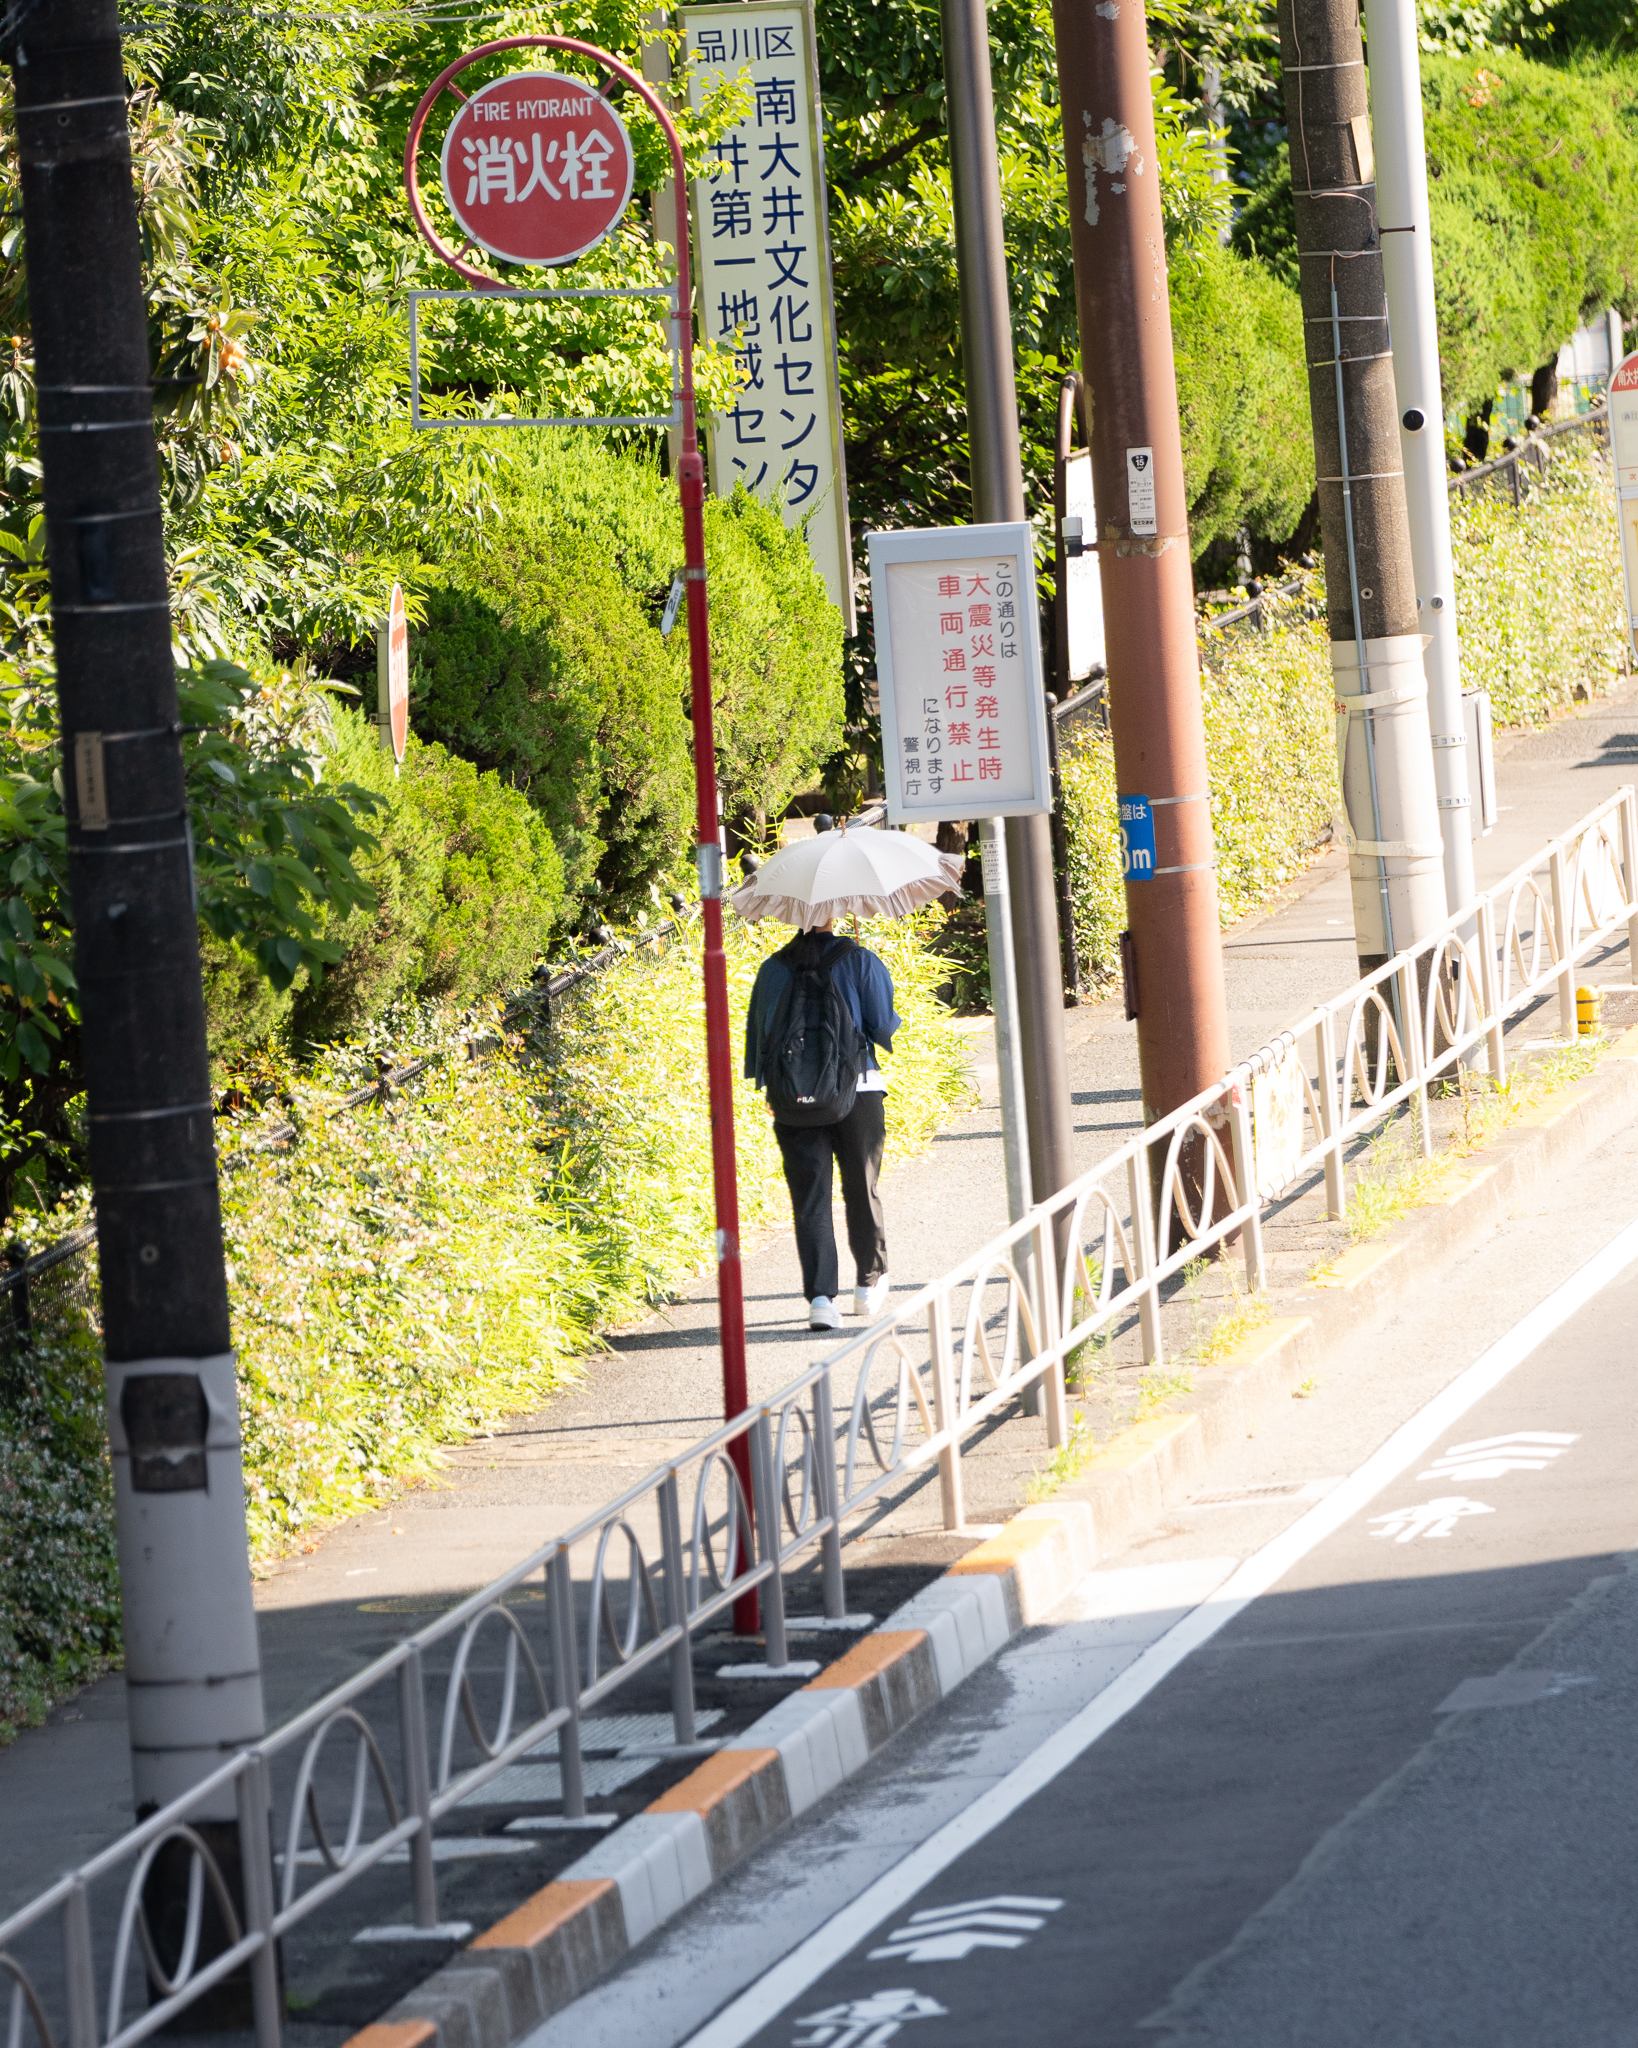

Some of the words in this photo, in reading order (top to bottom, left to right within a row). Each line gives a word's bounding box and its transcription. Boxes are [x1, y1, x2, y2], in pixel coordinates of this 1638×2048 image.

[696, 26, 795, 63] 品川区
[473, 101, 511, 122] FIRE
[516, 97, 593, 120] HYDRANT
[461, 128, 615, 206] 消火栓
[1135, 459, 1145, 467] 15
[995, 562, 1018, 660] この通りは
[937, 575, 975, 783] 車両通行禁止
[966, 573, 1003, 781] 大震災等発生時
[903, 736, 922, 797] 警視庁
[923, 697, 945, 795] になります
